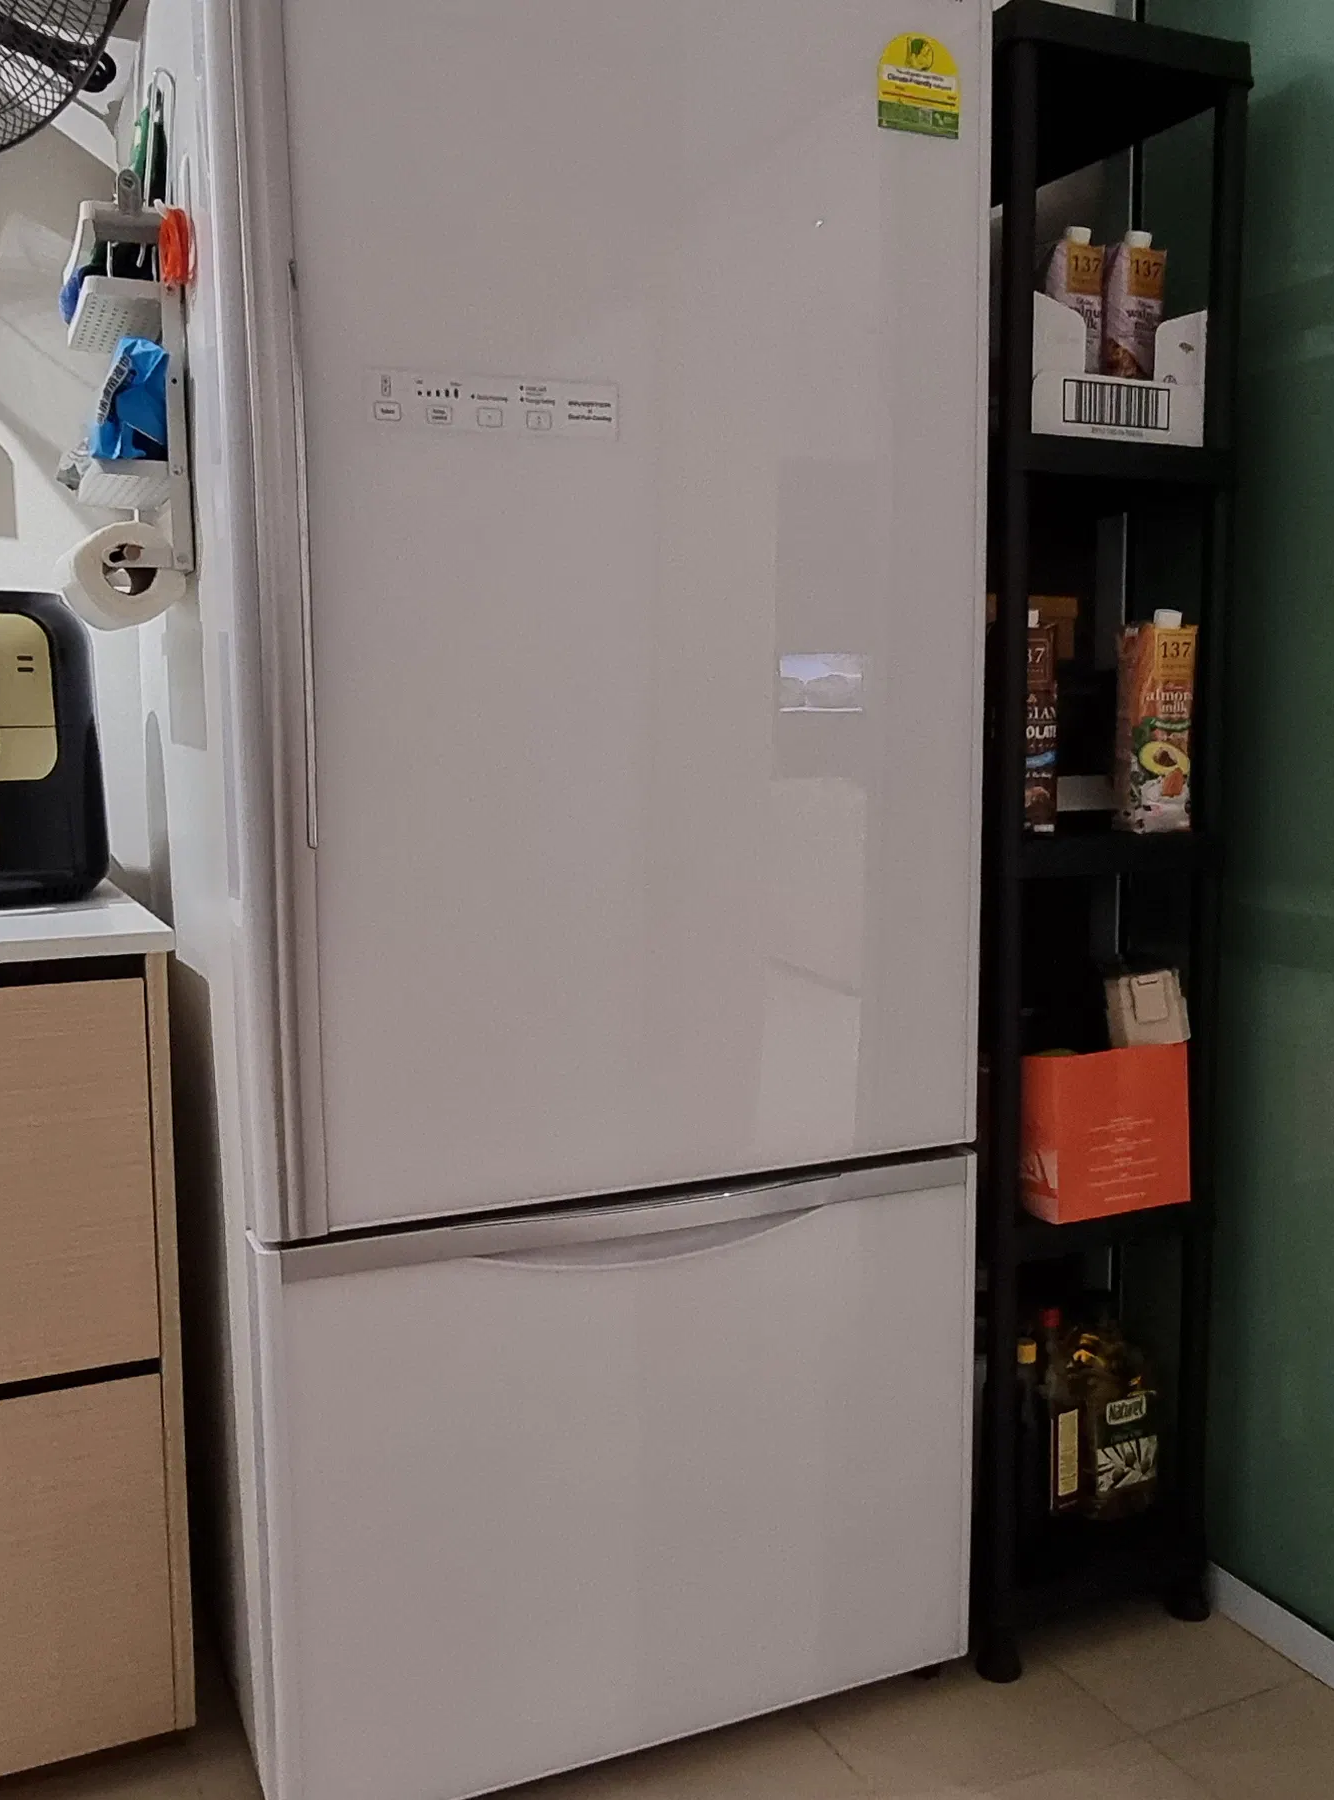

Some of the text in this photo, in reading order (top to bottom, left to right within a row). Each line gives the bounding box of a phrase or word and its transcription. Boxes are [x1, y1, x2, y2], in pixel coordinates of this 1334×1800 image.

[1072, 255, 1101, 273] 137
[1133, 259, 1163, 278] 137
[1026, 647, 1046, 664] 37
[1160, 640, 1192, 659] 137
